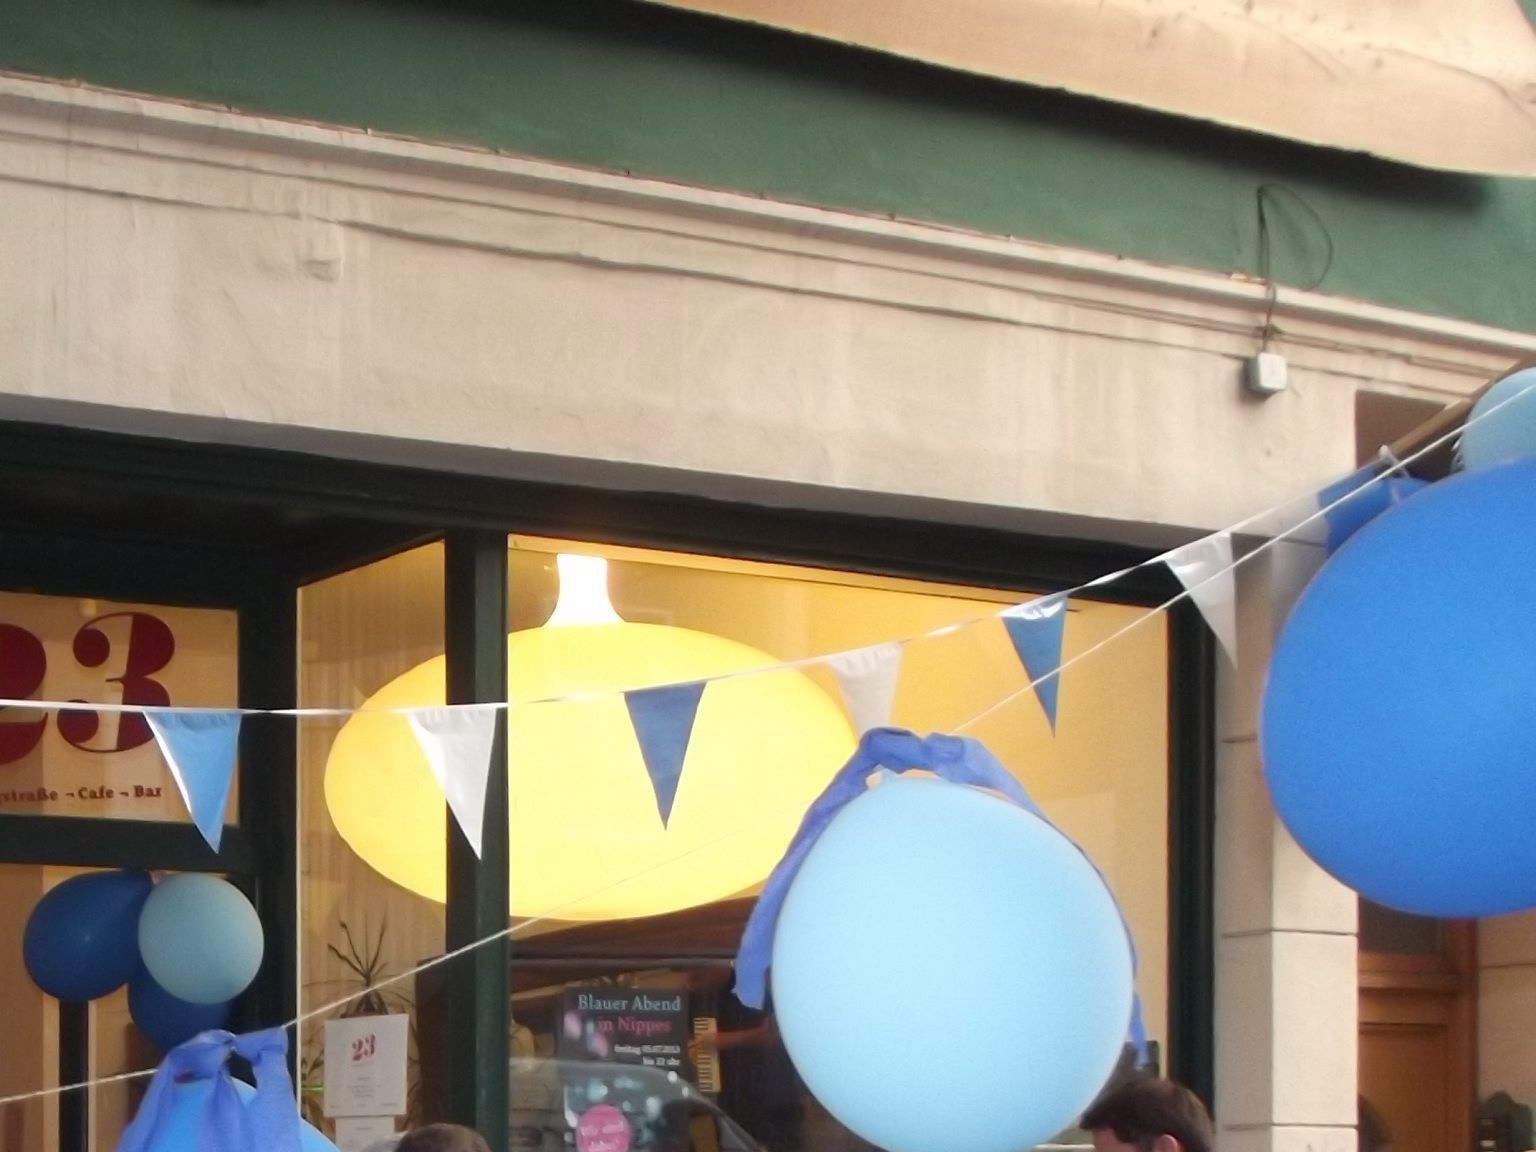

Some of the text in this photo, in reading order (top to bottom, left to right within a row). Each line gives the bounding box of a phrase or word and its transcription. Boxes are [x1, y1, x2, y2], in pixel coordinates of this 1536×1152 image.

[79, 785, 114, 800] Cafe
[133, 784, 163, 798] Bar
[578, 994, 681, 1011] Blauer Abend
[598, 1016, 672, 1036] in Nippes
[351, 1031, 376, 1061] 23
